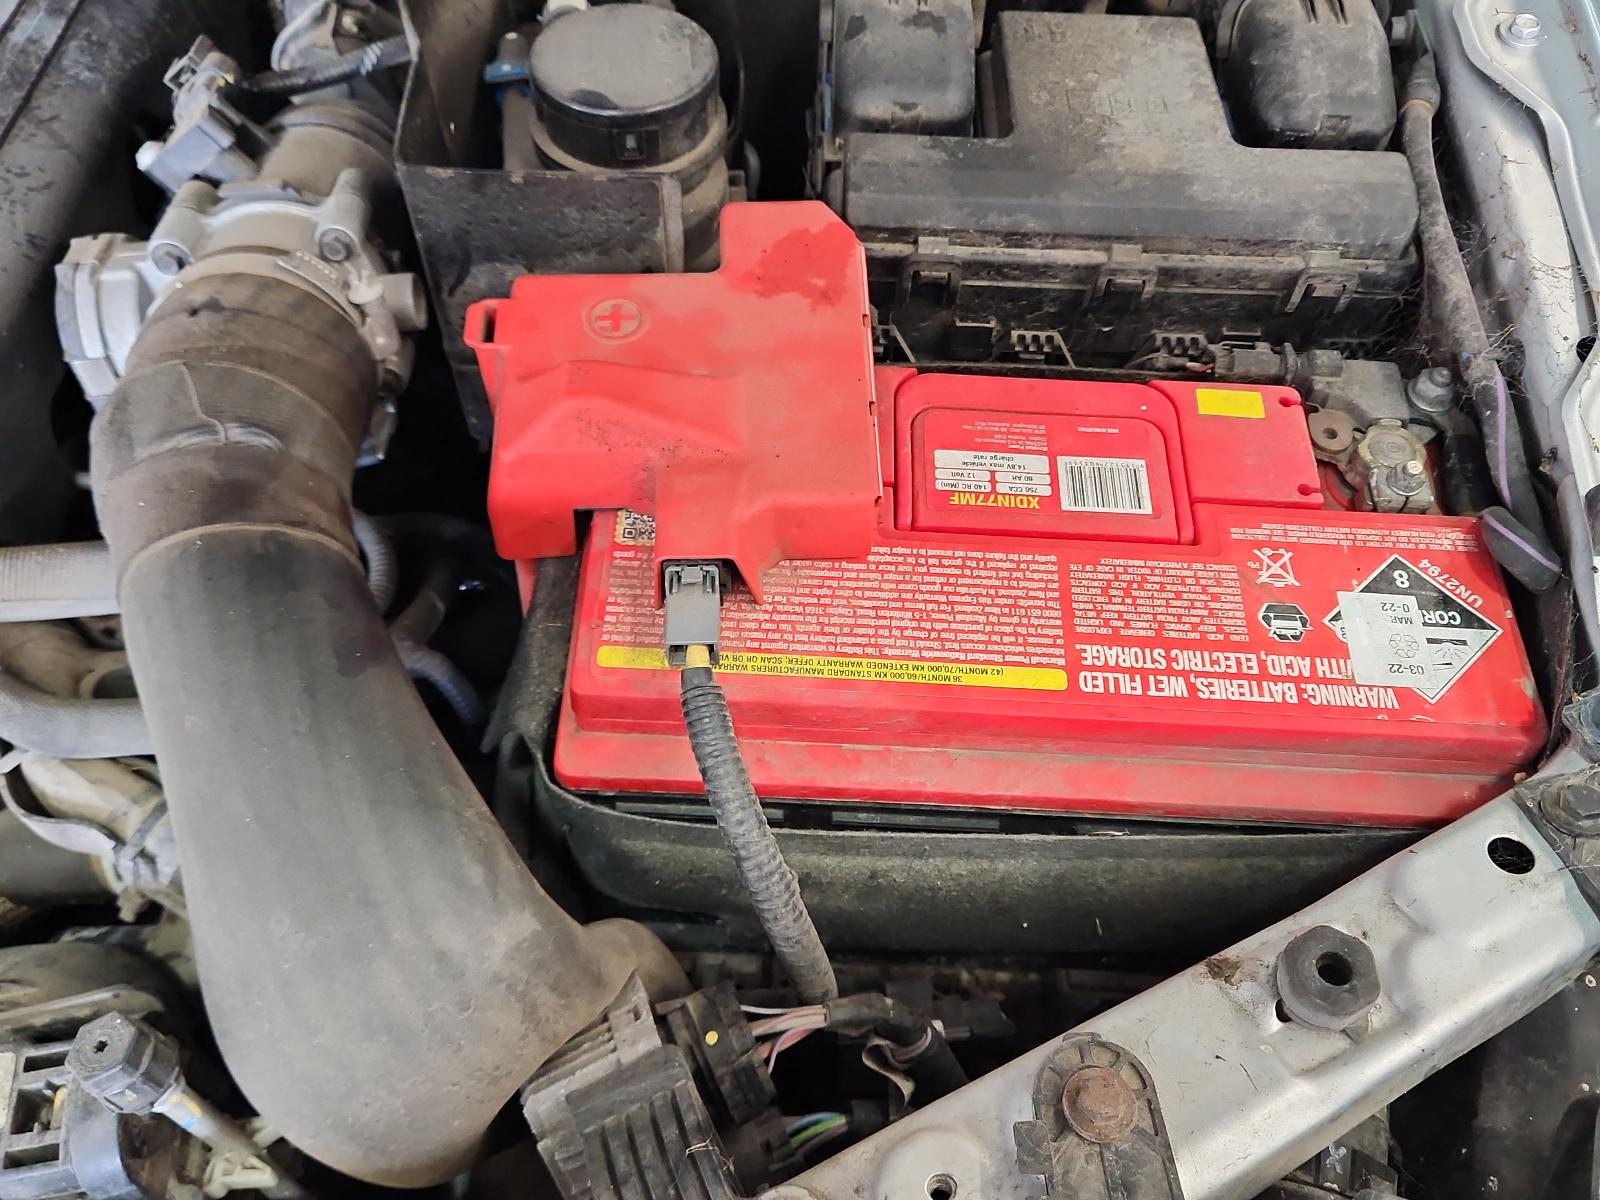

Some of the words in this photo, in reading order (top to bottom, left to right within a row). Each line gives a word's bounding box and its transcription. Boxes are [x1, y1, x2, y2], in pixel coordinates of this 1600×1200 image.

[940, 481, 960, 489] (Min)
[947, 492, 1041, 509] XDIN77MF
[1393, 570, 1410, 588] 8
[1418, 558, 1484, 608] UN2794
[1071, 587, 1101, 595] BATTERY
[1136, 598, 1166, 606] BATTERY
[1379, 602, 1410, 613] 0-22
[1137, 606, 1167, 614] BATTERY
[1420, 610, 1462, 625] COR
[1074, 626, 1112, 635] EXPLOSIVE
[760, 656, 783, 664] SCAN
[784, 656, 813, 666] OFFER;
[1076, 644, 1166, 668] STORAGE.
[1170, 648, 1259, 674] ELECTRIC
[711, 662, 748, 672] WARRAN
[816, 659, 863, 668] WARRANTY
[866, 662, 908, 671] EXTENDED
[1260, 651, 1311, 677] ACID,
[750, 664, 824, 676] MANUFACTURERS
[827, 668, 871, 678] STANDARD
[874, 671, 887, 679] KM
[927, 664, 987, 675] MONTH/70,000
[991, 667, 1003, 676] (42
[1388, 664, 1424, 675] 03-22
[890, 671, 951, 682] MONTH/60,000
[1079, 671, 1142, 695] FILLED
[1148, 674, 1188, 698] WET
[1190, 673, 1298, 704] BATTERIES,
[1301, 683, 1400, 709] WARNING:
